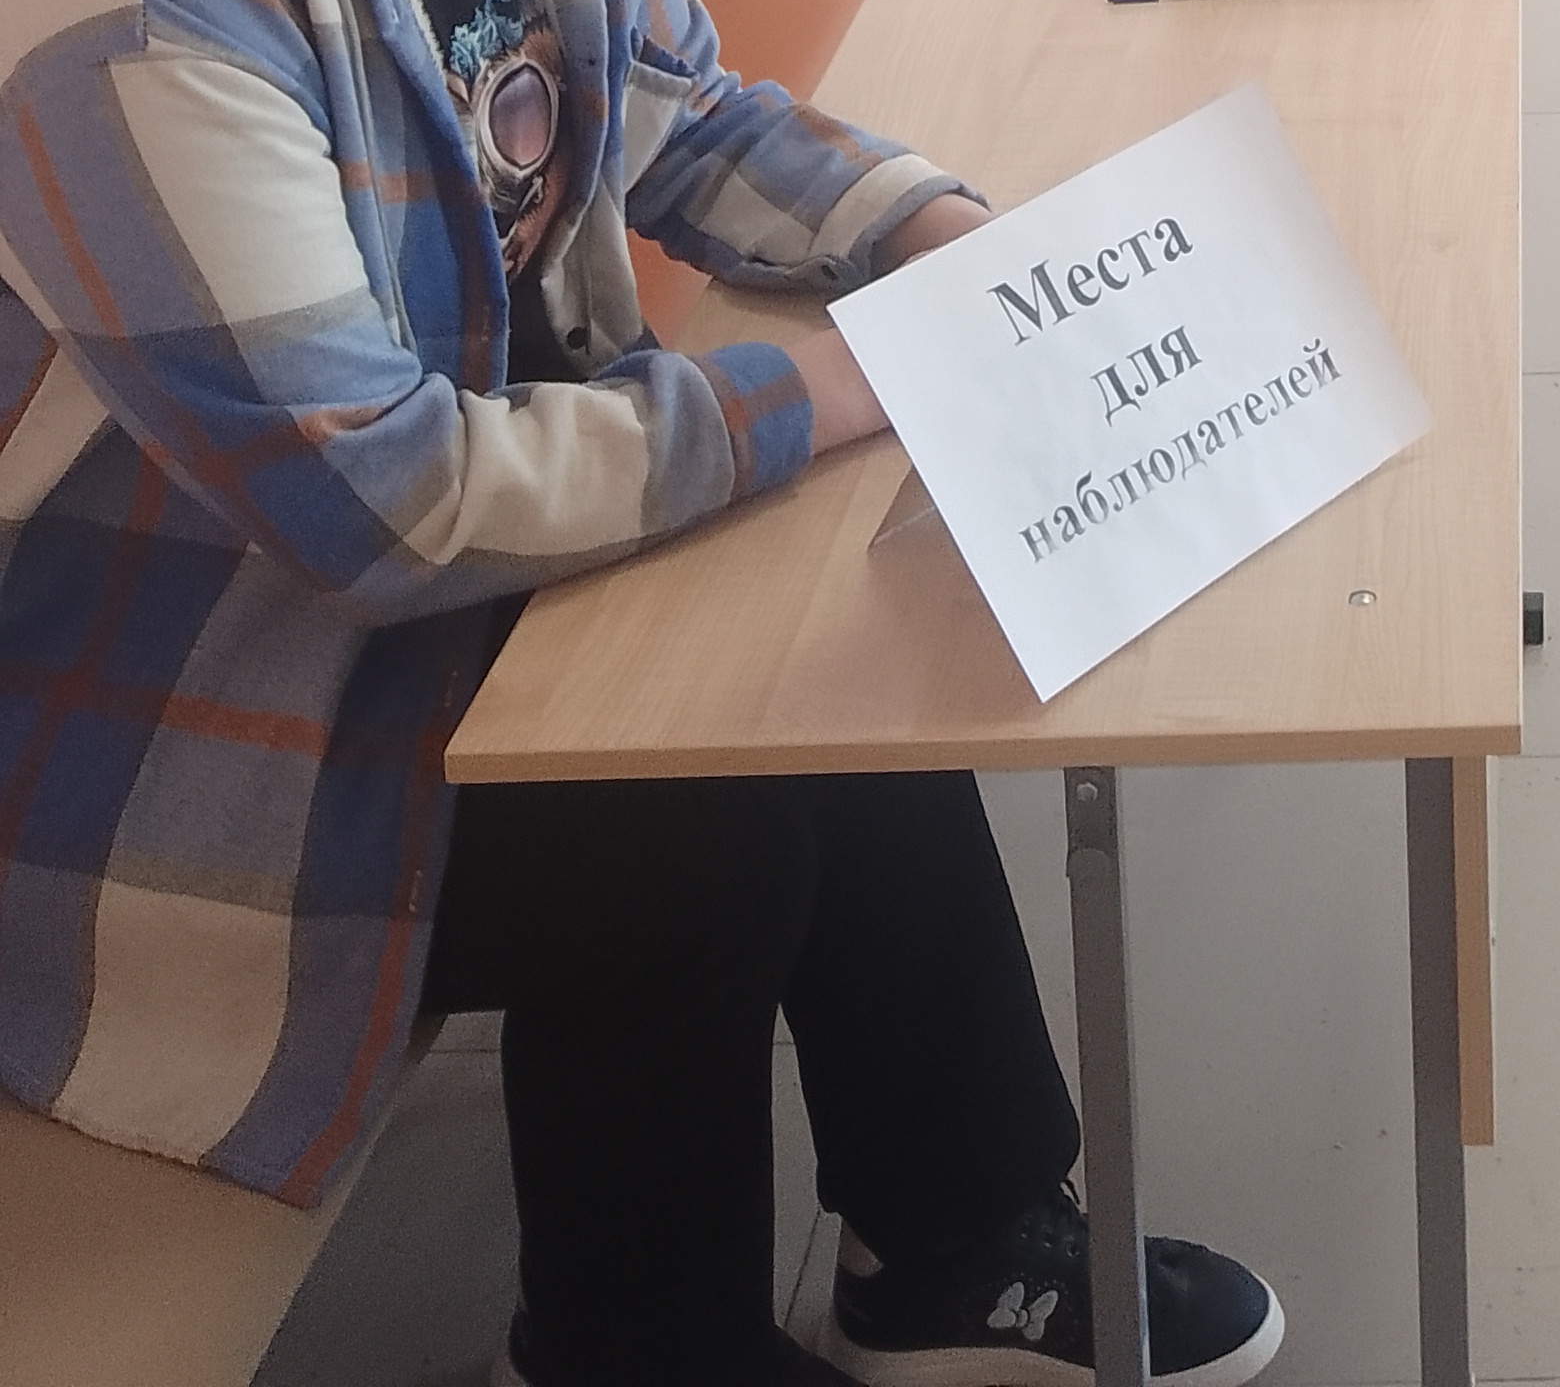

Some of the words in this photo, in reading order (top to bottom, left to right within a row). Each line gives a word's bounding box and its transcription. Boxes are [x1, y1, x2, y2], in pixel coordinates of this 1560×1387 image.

[985, 217, 1194, 347] Места
[1090, 325, 1203, 428] для
[1018, 337, 1342, 564] наблюдателей
